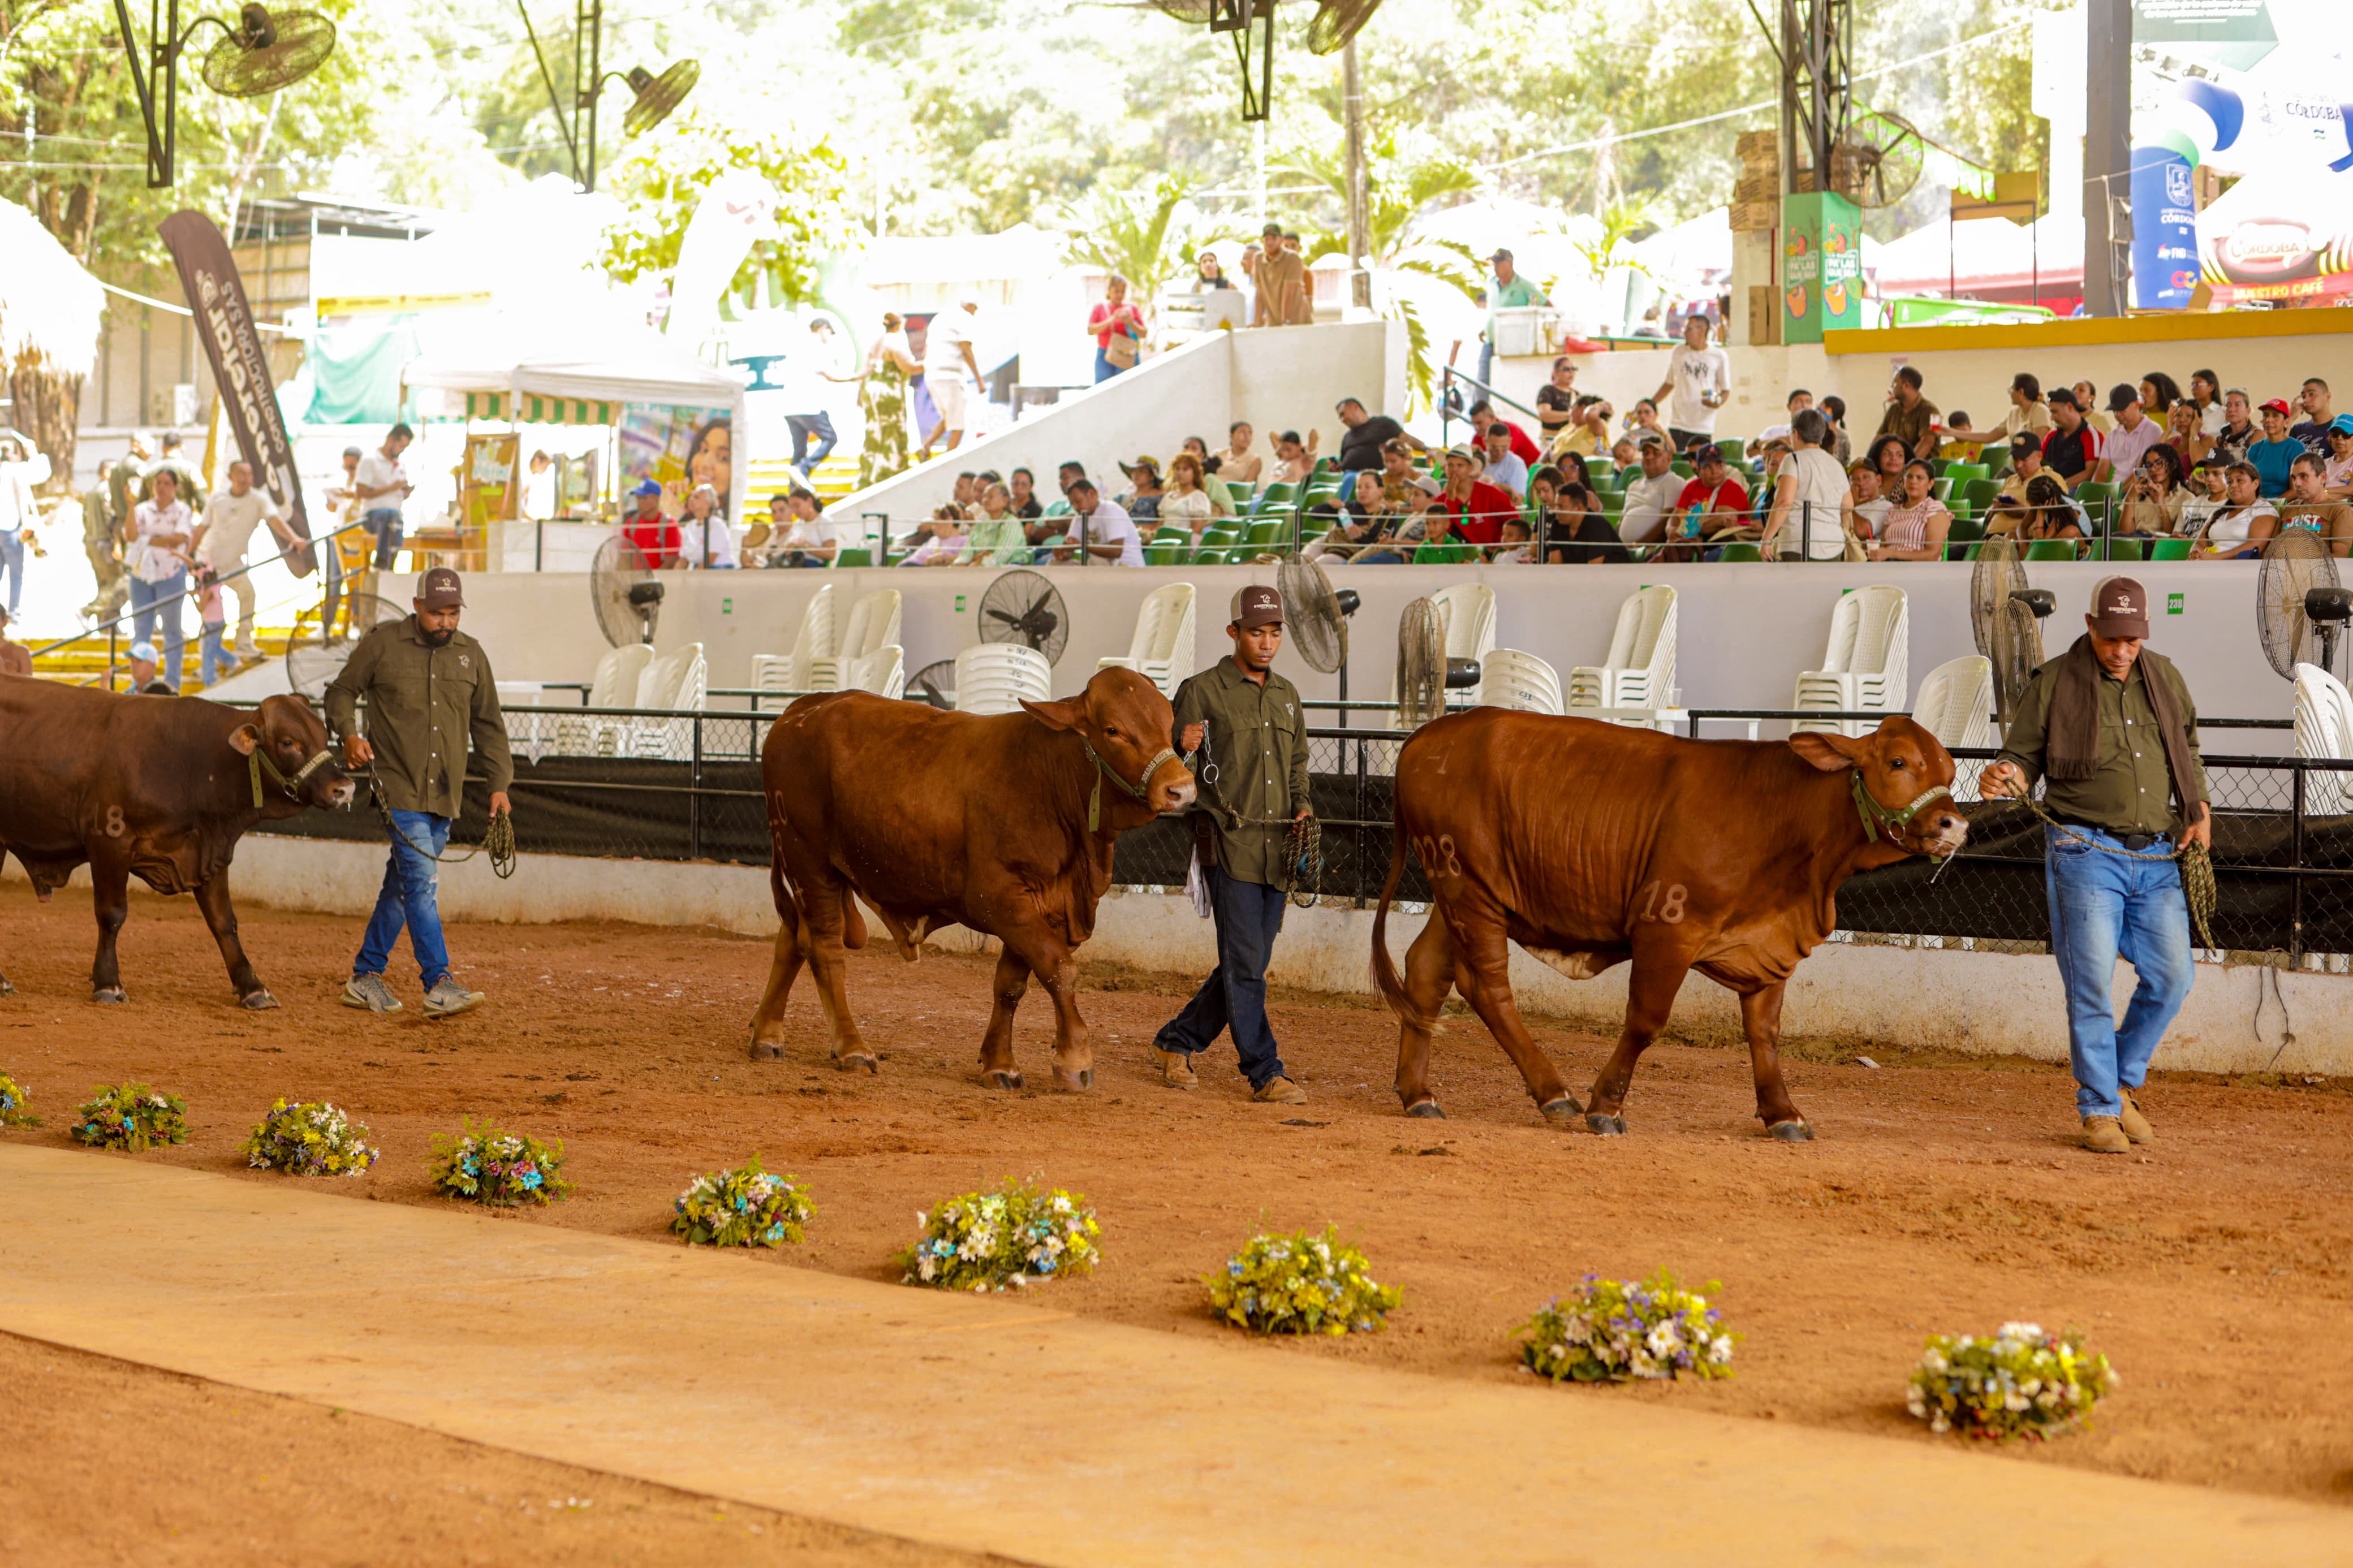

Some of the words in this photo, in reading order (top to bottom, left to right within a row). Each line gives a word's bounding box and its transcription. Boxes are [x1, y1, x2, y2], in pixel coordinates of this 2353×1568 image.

[2292, 276, 2325, 295] CAFÉ
[2169, 598, 2183, 610] 23B
[1910, 790, 1935, 811] BOADAS
[91, 802, 126, 837] 18
[1641, 880, 1688, 924] 18
